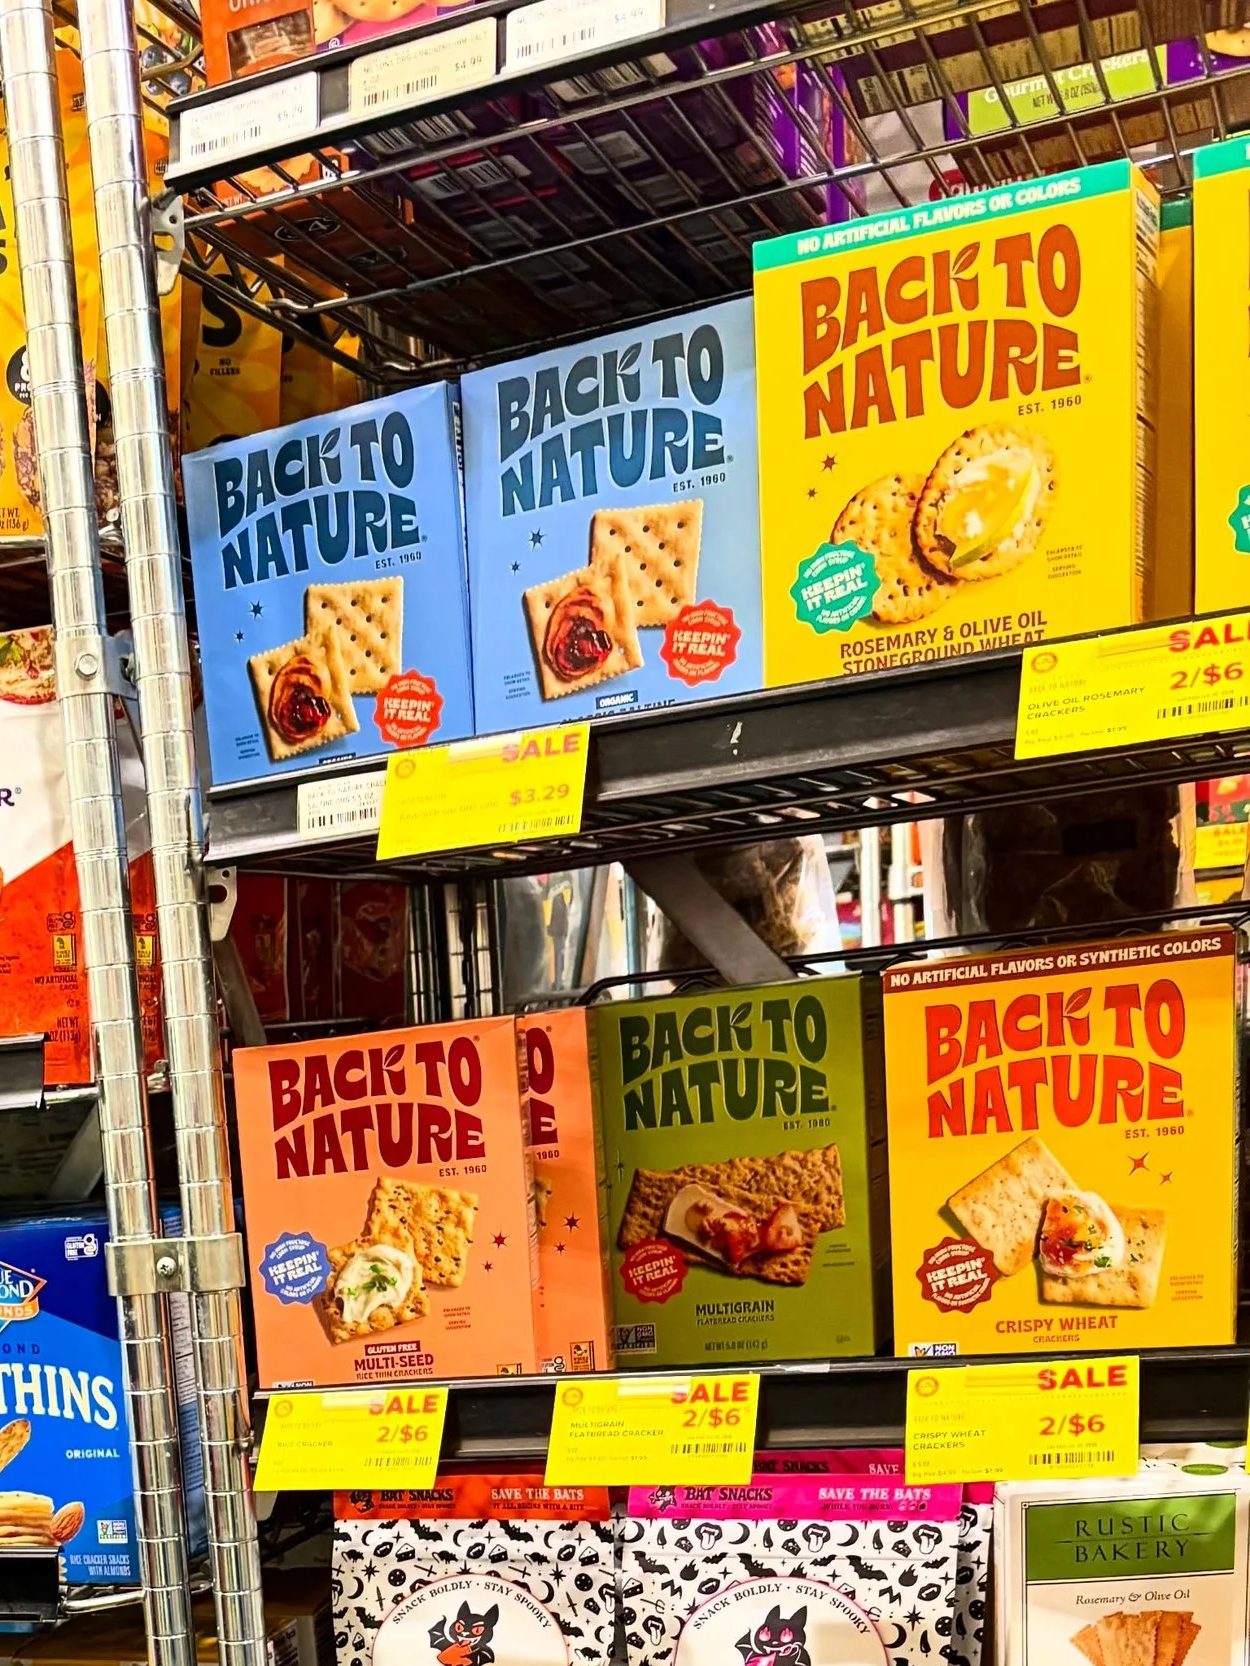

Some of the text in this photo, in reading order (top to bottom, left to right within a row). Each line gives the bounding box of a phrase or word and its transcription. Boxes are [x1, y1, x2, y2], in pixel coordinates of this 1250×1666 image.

[796, 177, 1082, 256] NO ARTIFICIAL FLAVORS OR COLORS
[800, 224, 1082, 376] BACK TO
[804, 319, 1083, 440] NATURE
[214, 411, 415, 539] BACK TO
[221, 489, 422, 590] NATURE
[375, 551, 422, 570] EST. 1960
[672, 628, 732, 647] KEEPIN'
[839, 609, 1048, 659] ROSEMARY & OLIVE OIL
[687, 640, 726, 656] REAL
[1170, 662, 1243, 690] 2/$6
[598, 692, 636, 708] ORGANIC
[501, 731, 582, 764] SALE
[509, 783, 570, 808] $3.29
[890, 937, 1222, 988] NO ARTIFICIAL FLAVORS OR SYNTHETIC COLORS
[924, 978, 1187, 1086] BACK TO
[927, 1054, 1186, 1138] NATURE
[694, 1299, 775, 1316] MULTIGRAIN
[995, 1314, 1118, 1335] CRISPY WHEAT
[1032, 1333, 1081, 1344] CRACKERS
[354, 1353, 435, 1372] MULTI-SEED
[1037, 1365, 1128, 1392] SALE
[569, 1420, 626, 1430] MULTIGRAIN
[569, 1428, 665, 1439] FLATBREAD CRACKER
[913, 1429, 987, 1441] CRISPY WHEAT
[1038, 1413, 1106, 1435] 2/$6
[66, 1448, 120, 1460] ORIGINAL
[1074, 1512, 1191, 1538] RUSTIC
[1074, 1539, 1190, 1564] BAKERY
[391, 1581, 553, 1630] SNACK BOLDLY STAY SPOOKY
[1075, 1588, 1191, 1608] Rosemary Olive Oil
